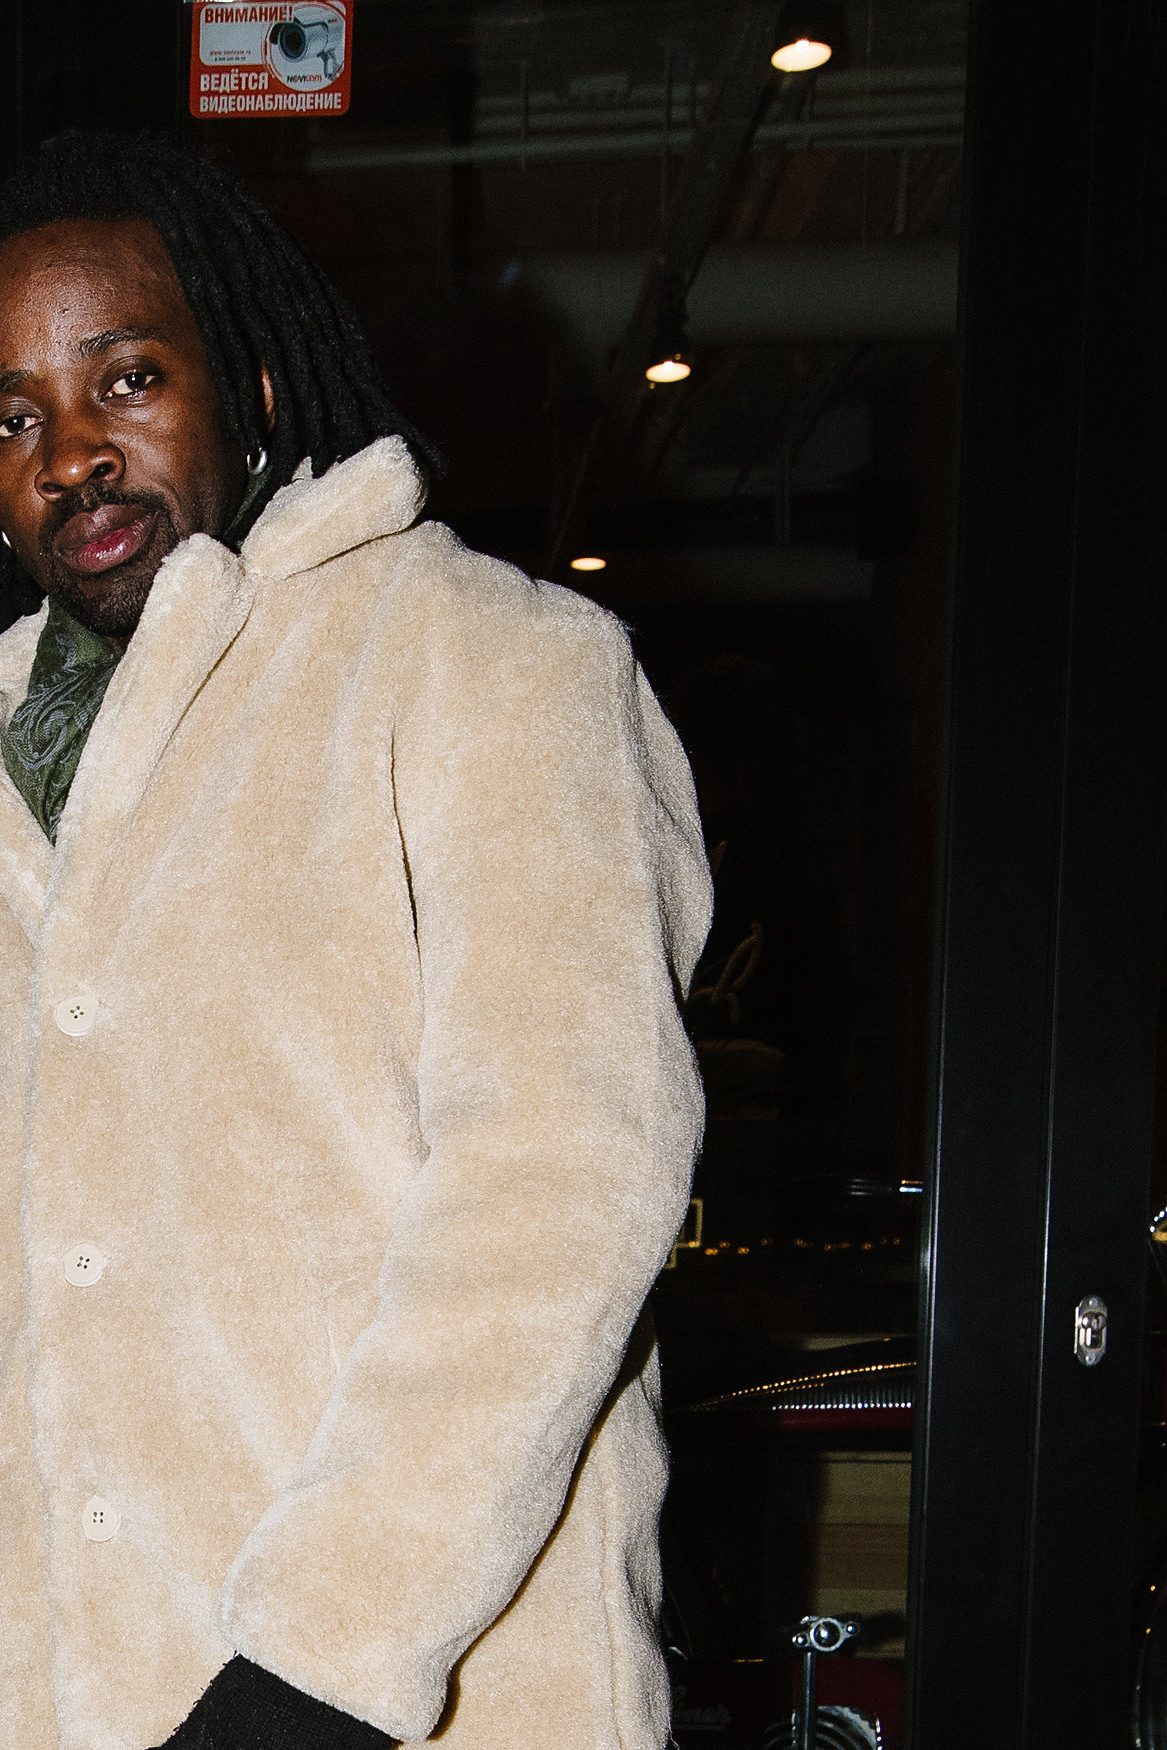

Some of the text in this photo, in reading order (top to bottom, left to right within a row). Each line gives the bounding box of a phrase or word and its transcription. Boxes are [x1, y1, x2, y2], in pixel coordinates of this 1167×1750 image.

[204, 6, 293, 24] ВНИМАНИЕ!
[200, 69, 269, 93] ВЕДЁТСЯ
[199, 92, 342, 115] ВИДЕОНАБЛЮДЕНИЕ
